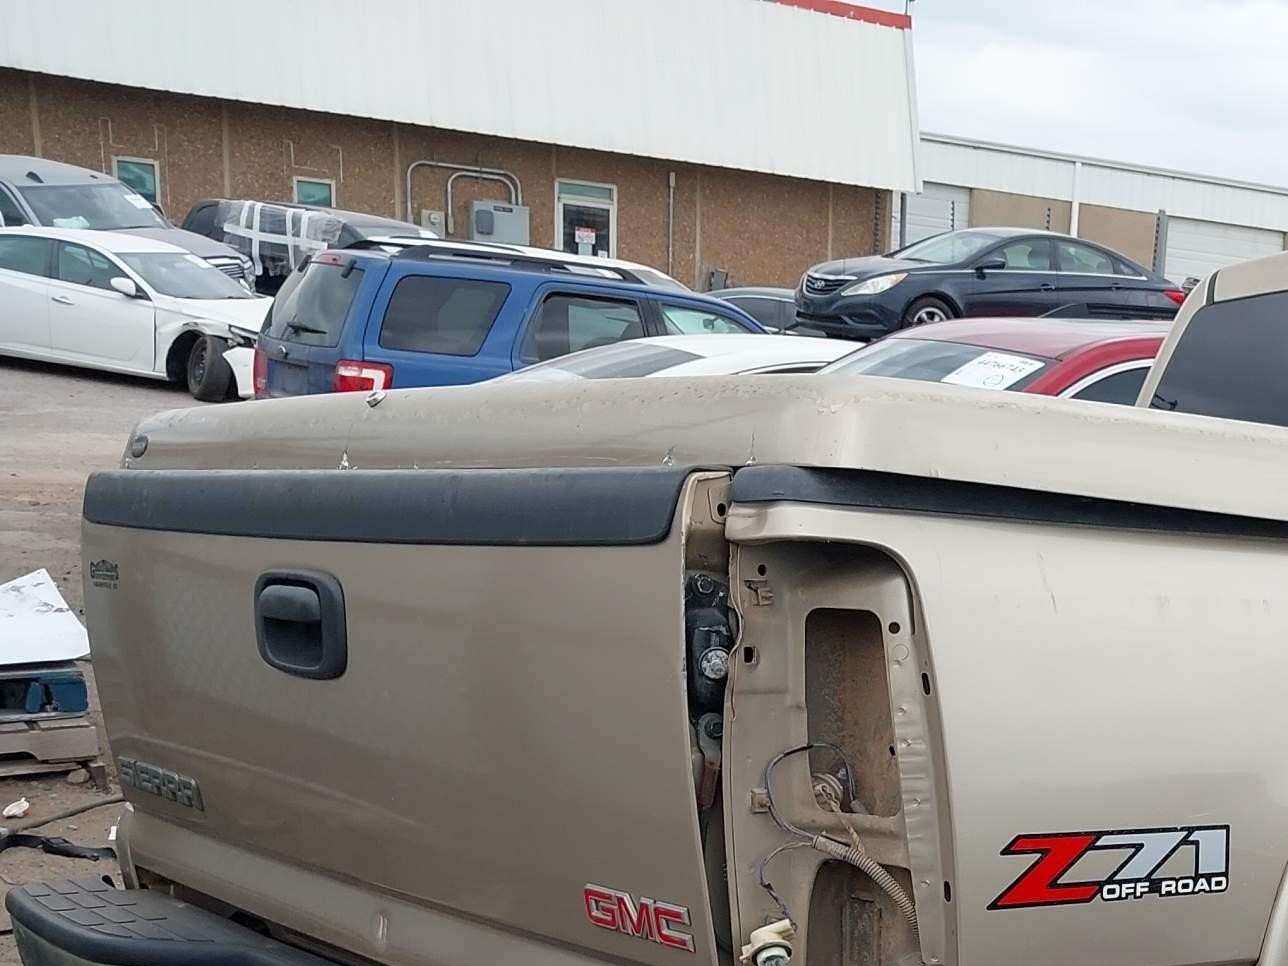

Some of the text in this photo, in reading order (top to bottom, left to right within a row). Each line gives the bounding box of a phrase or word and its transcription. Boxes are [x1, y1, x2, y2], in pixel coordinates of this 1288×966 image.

[986, 824, 1230, 910] Z71
[1102, 876, 1228, 900] OFF ROAD
[584, 882, 696, 953] GMC
